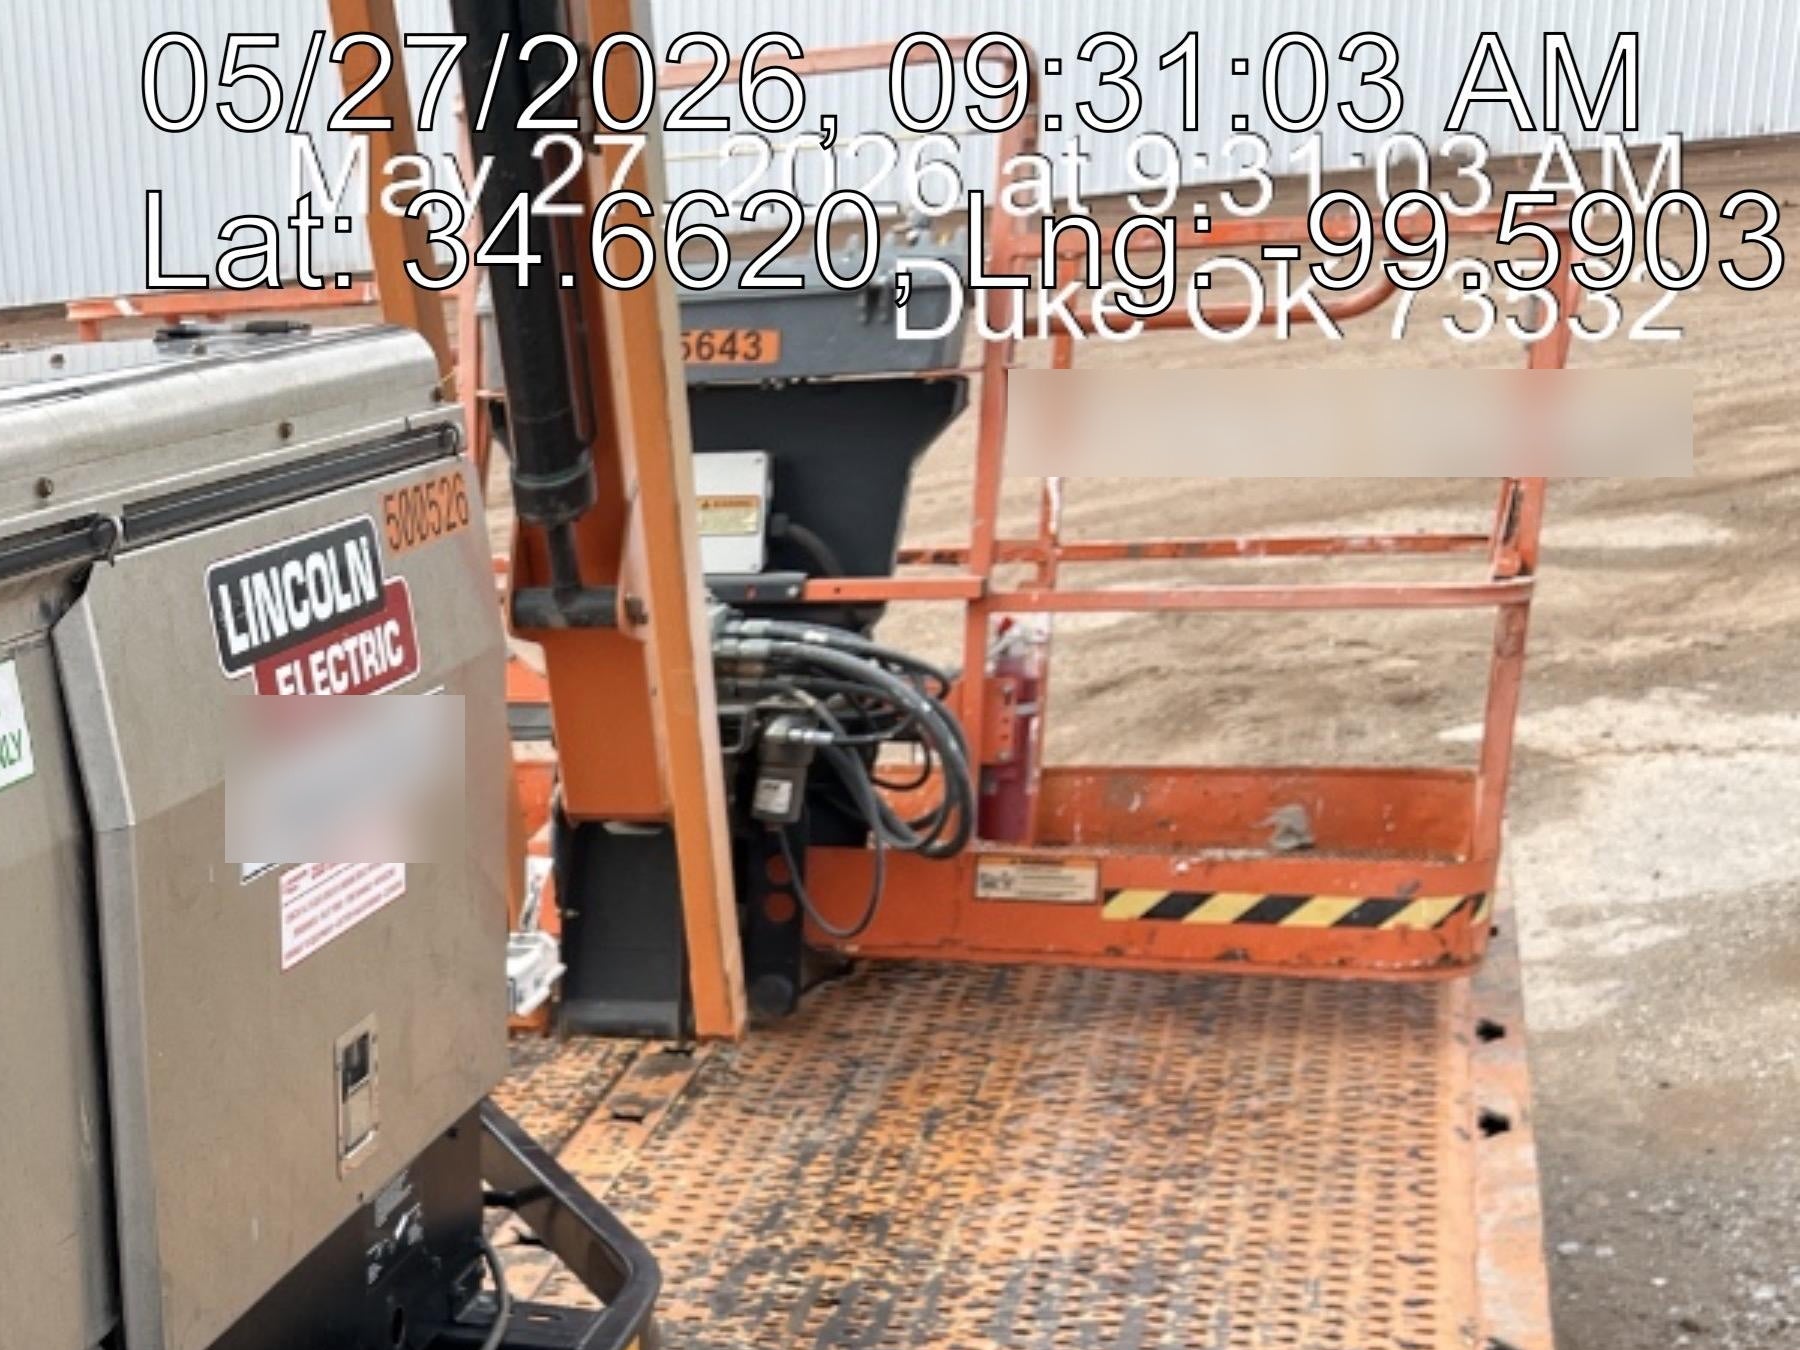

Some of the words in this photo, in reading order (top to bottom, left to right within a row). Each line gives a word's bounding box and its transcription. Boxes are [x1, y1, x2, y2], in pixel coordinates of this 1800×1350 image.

[383, 471, 470, 550] 500526
[218, 536, 380, 655] LINCOLN
[274, 619, 404, 696] ELECTRIC
